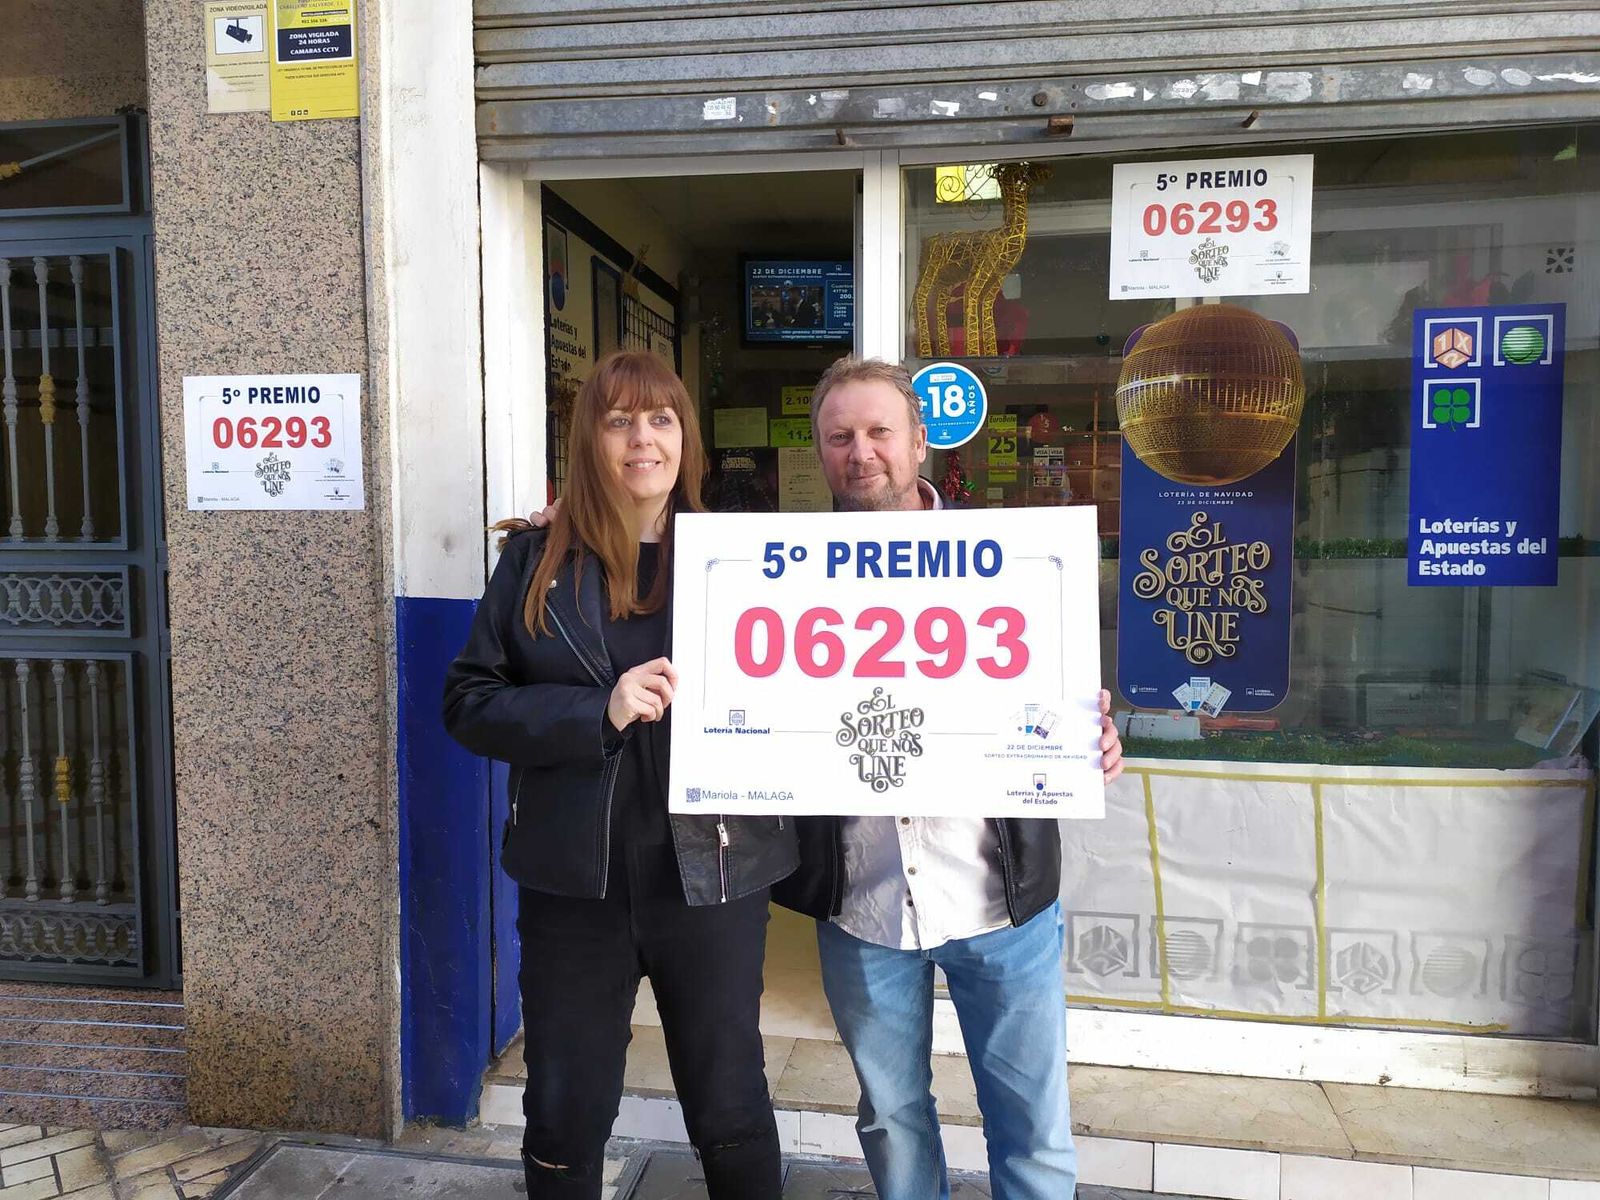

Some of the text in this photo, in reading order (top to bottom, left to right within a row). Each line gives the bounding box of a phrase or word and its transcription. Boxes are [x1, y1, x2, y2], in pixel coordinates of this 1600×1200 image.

[1185, 168, 1268, 190] PREMIO
[1142, 198, 1278, 237] 06293
[1188, 245, 1229, 265] SORTEO
[551, 334, 577, 357] Apuestas
[248, 386, 321, 404] PREMIO
[966, 384, 977, 415] AÑOS
[212, 416, 332, 449] 06293
[990, 436, 1016, 454] 25
[255, 460, 291, 478] SORTEO
[1166, 510, 1226, 552] EL
[1419, 516, 1518, 537] Loterías y
[762, 538, 1003, 580] 5º PREMIO
[1419, 537, 1547, 558] Apuestas del
[1133, 541, 1271, 599] SORTEO
[1418, 559, 1486, 576] Estado
[1166, 575, 1267, 614] QUE NOS
[734, 606, 1030, 680] 06293
[1152, 609, 1240, 665] UNE
[857, 686, 897, 715] EL
[735, 726, 771, 735] Nacional
[836, 707, 925, 747] SORTEO
[857, 733, 924, 757] QUE NOS
[849, 754, 907, 794] UNE
[701, 789, 739, 800] Mariola
[747, 790, 795, 801] MALAGA
[1034, 797, 1058, 805] Estado
[1036, 790, 1041, 798] y
[1042, 790, 1074, 799] Apuestas
